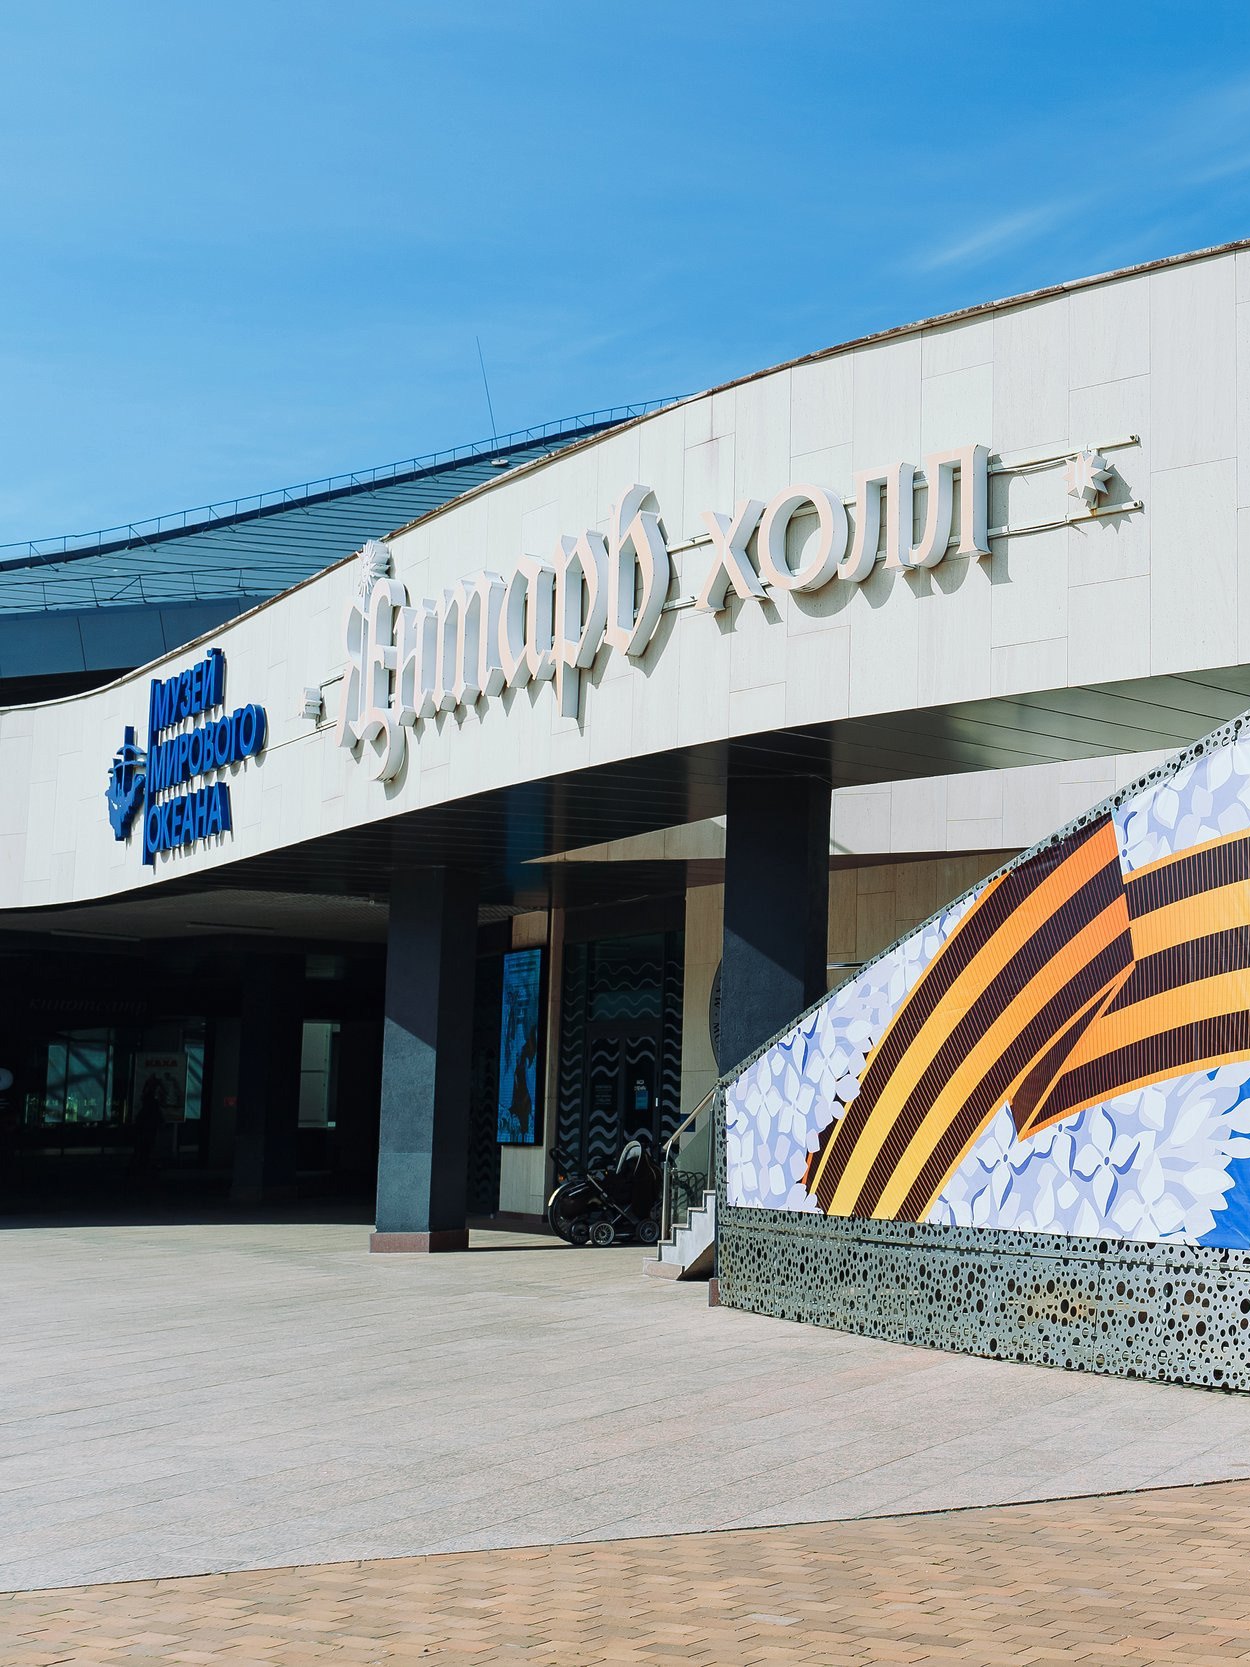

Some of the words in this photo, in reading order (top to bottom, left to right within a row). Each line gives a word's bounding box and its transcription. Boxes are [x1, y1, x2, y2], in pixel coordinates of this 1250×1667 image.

[338, 484, 668, 782] Янтарь
[152, 648, 223, 732] МУЗЕЙ
[150, 703, 264, 793] МИРОВОГО
[146, 782, 230, 854] ОКЕАНА
